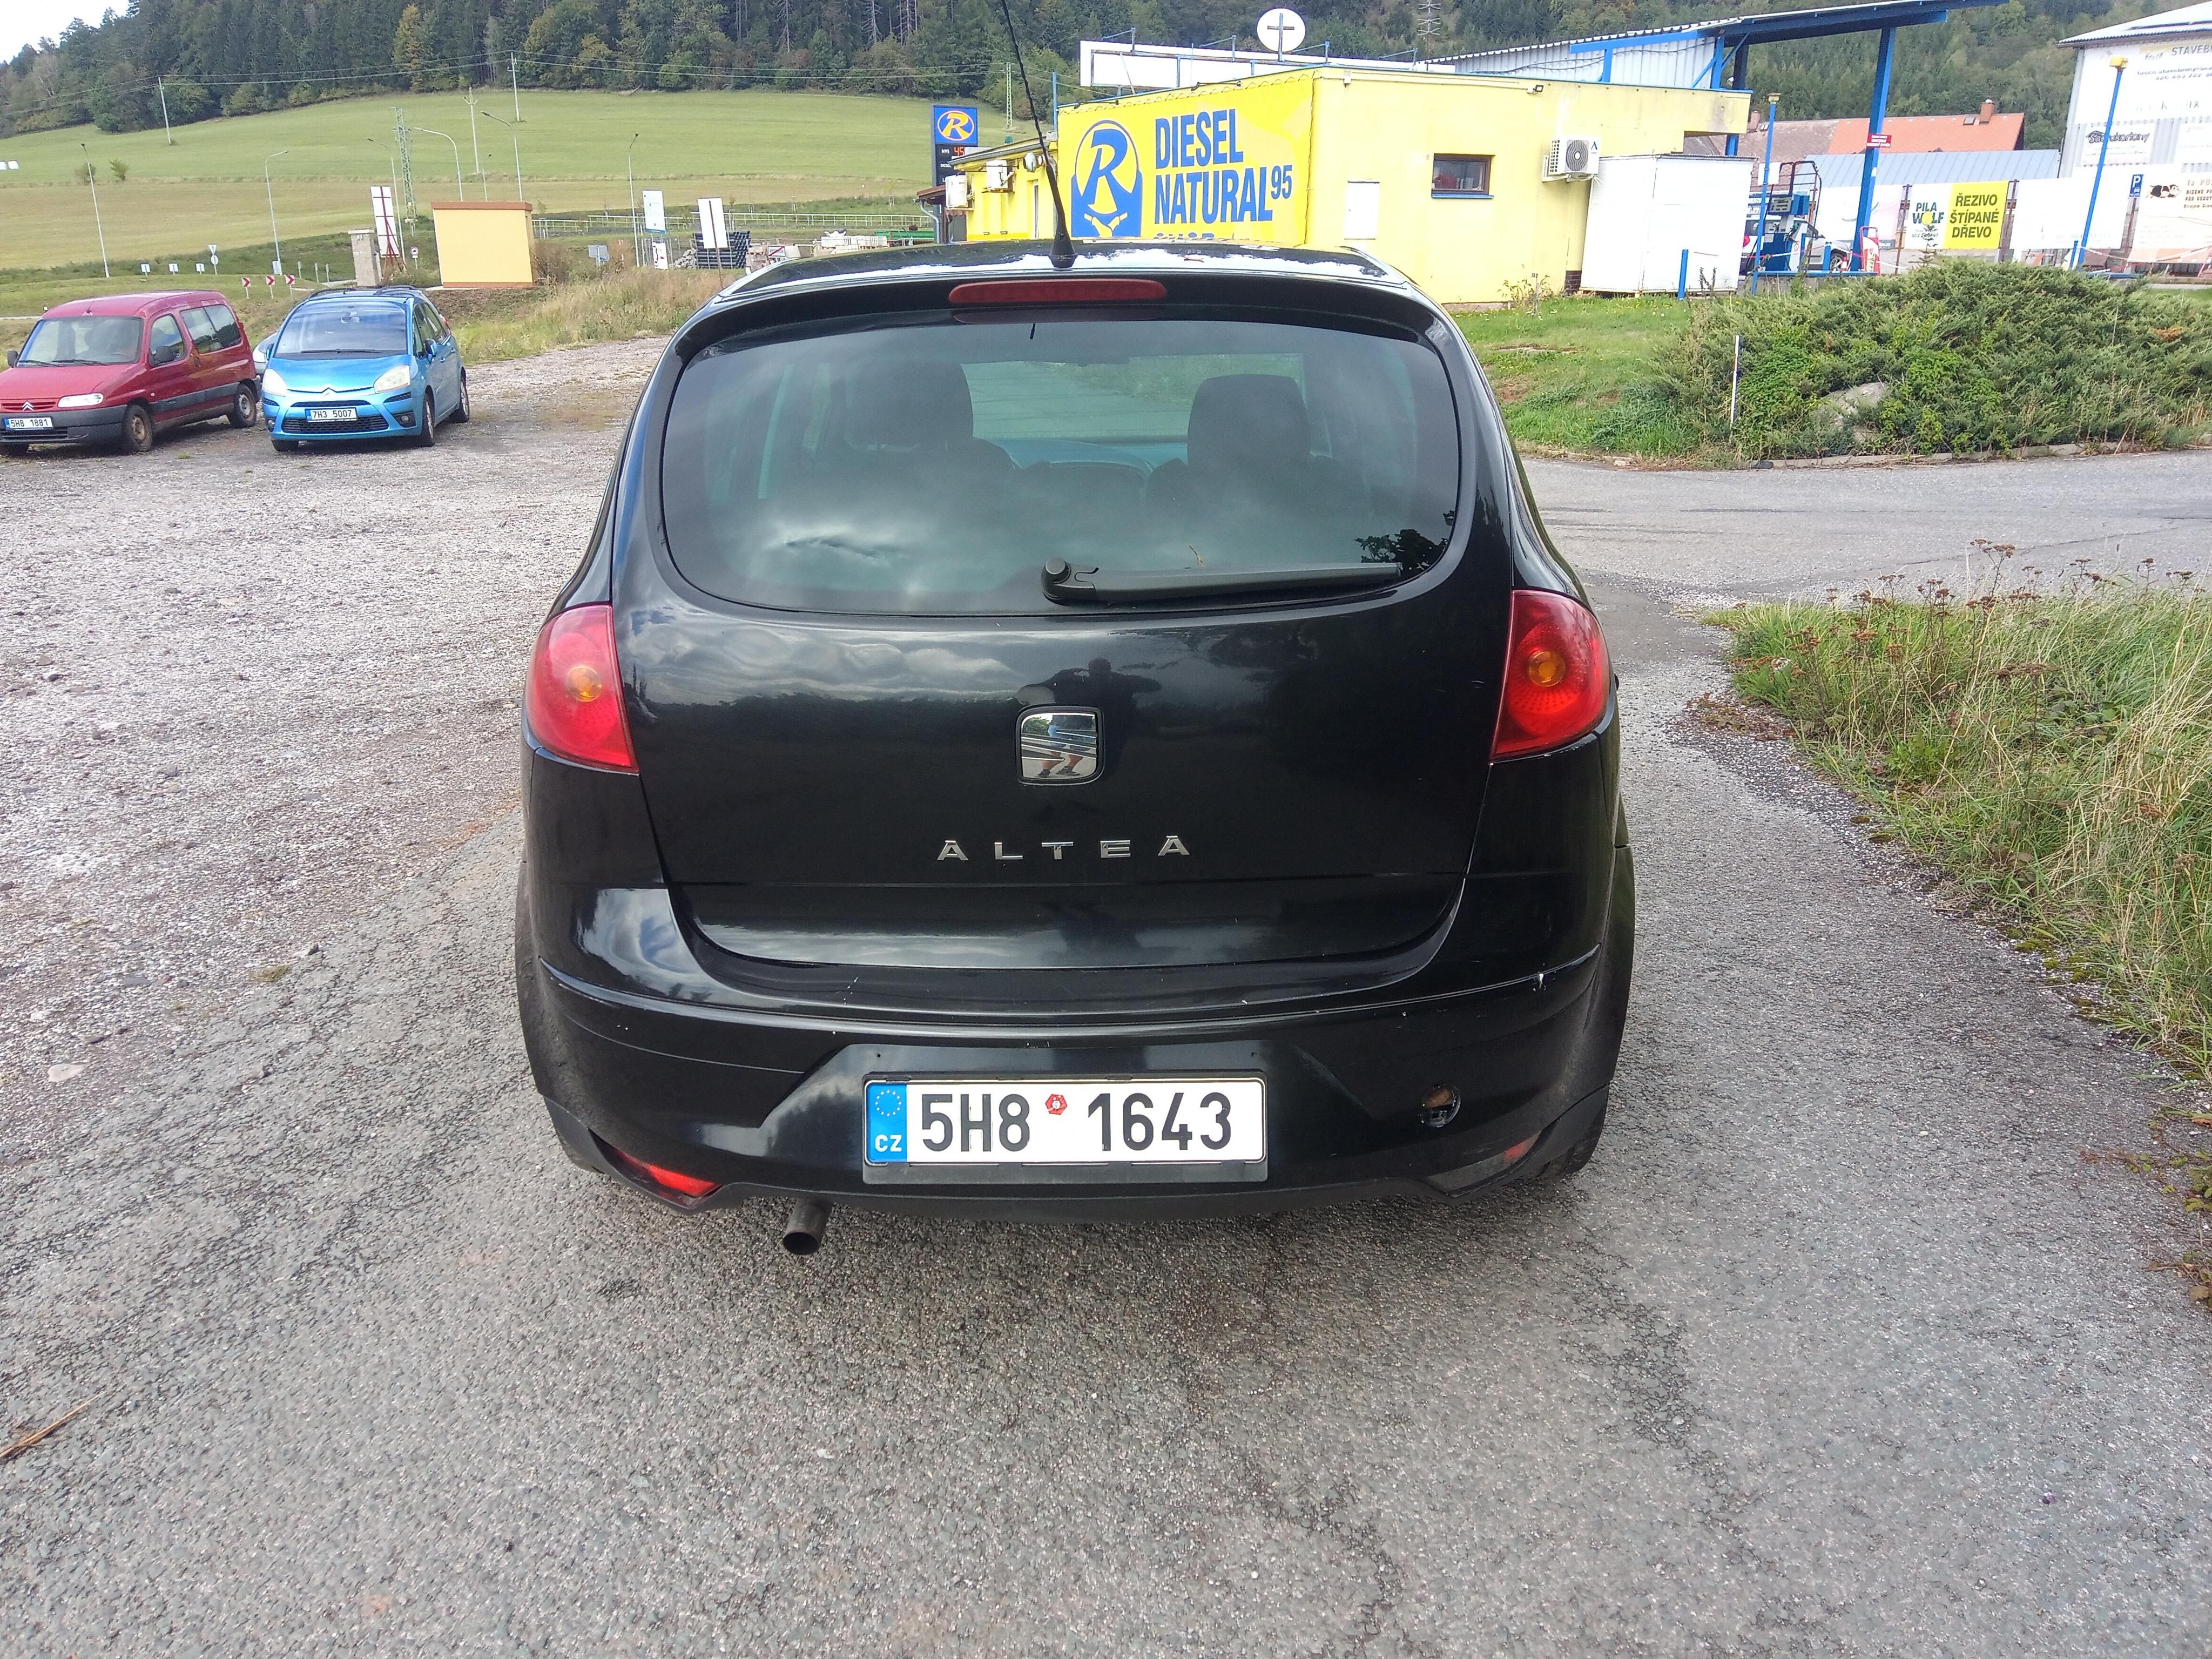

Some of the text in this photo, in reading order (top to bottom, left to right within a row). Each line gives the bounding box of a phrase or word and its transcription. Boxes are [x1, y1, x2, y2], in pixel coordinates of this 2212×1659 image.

[2171, 44, 2212, 56] STAVEB
[1155, 108, 1244, 170] DIESEL
[2133, 176, 2141, 188] P
[1154, 165, 1293, 225] NATURAL 95
[1955, 192, 1998, 207] ŘEZIVO
[1916, 202, 1937, 212] PILA
[1912, 212, 1944, 224] WLF
[1950, 208, 2000, 224] ŠTÍPANÉ
[1952, 224, 1992, 238] DŘEVO
[312, 409, 352, 419] 7H3 5007
[10, 419, 49, 427] 5H8 1881
[938, 835, 1190, 861] ALTEA
[874, 1092, 1232, 1152] CZ 5H8 1643
